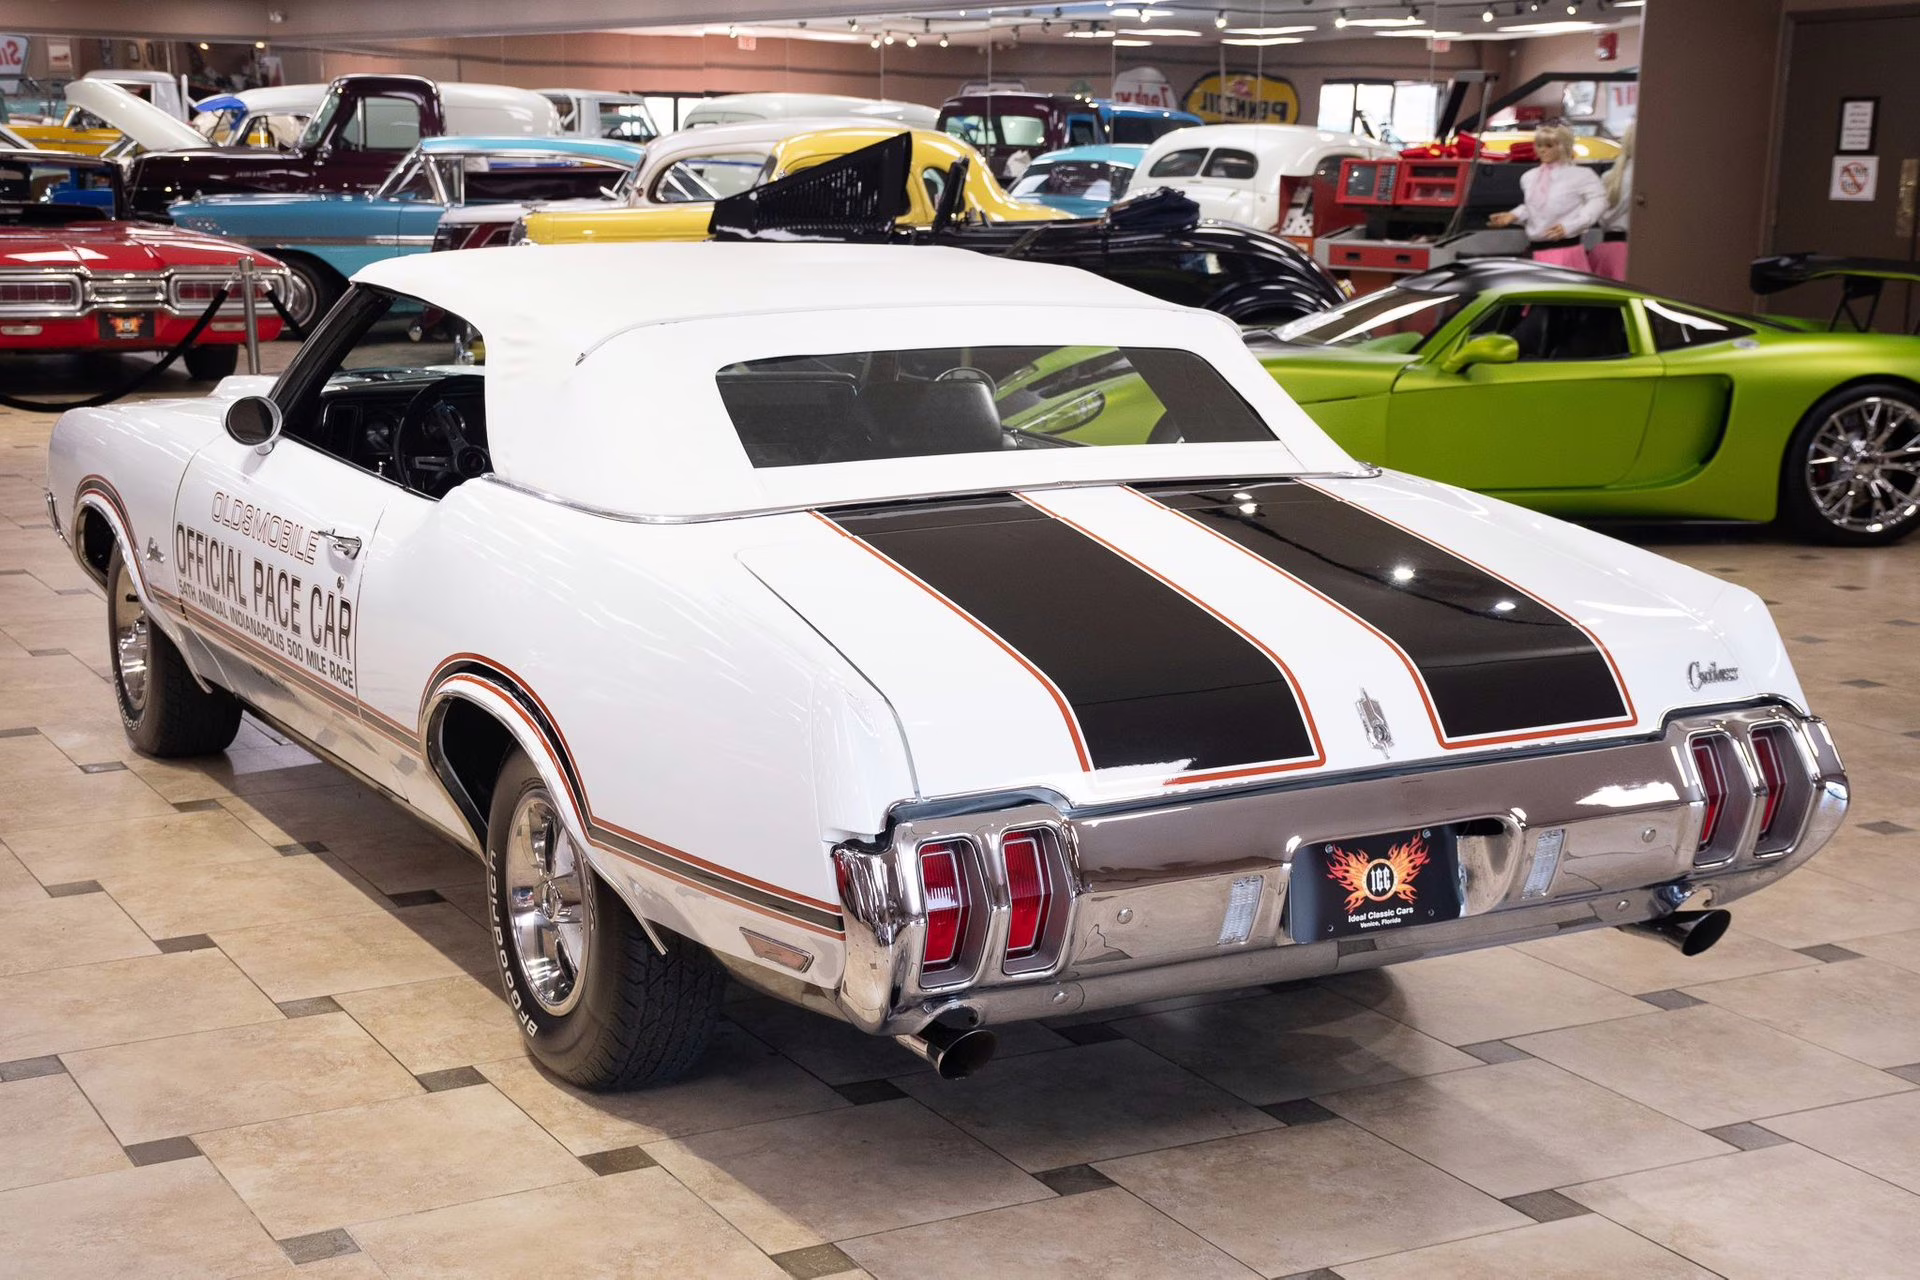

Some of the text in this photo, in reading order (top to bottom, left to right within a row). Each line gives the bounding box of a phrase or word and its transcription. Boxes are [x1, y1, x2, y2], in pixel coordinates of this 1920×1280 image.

[211, 491, 320, 565] OLDSMOBILE
[175, 522, 353, 662] OFFICIAL PACE CAR
[178, 579, 354, 690] 54TH ANNUAL INDIANAPOLIS 500 MILE RACE
[1348, 906, 1414, 923] Ideal Classic Cars
[1370, 866, 1391, 895] ICC
[489, 849, 539, 1038] BFGoodrich
[1360, 917, 1402, 929] Venice, Florida
